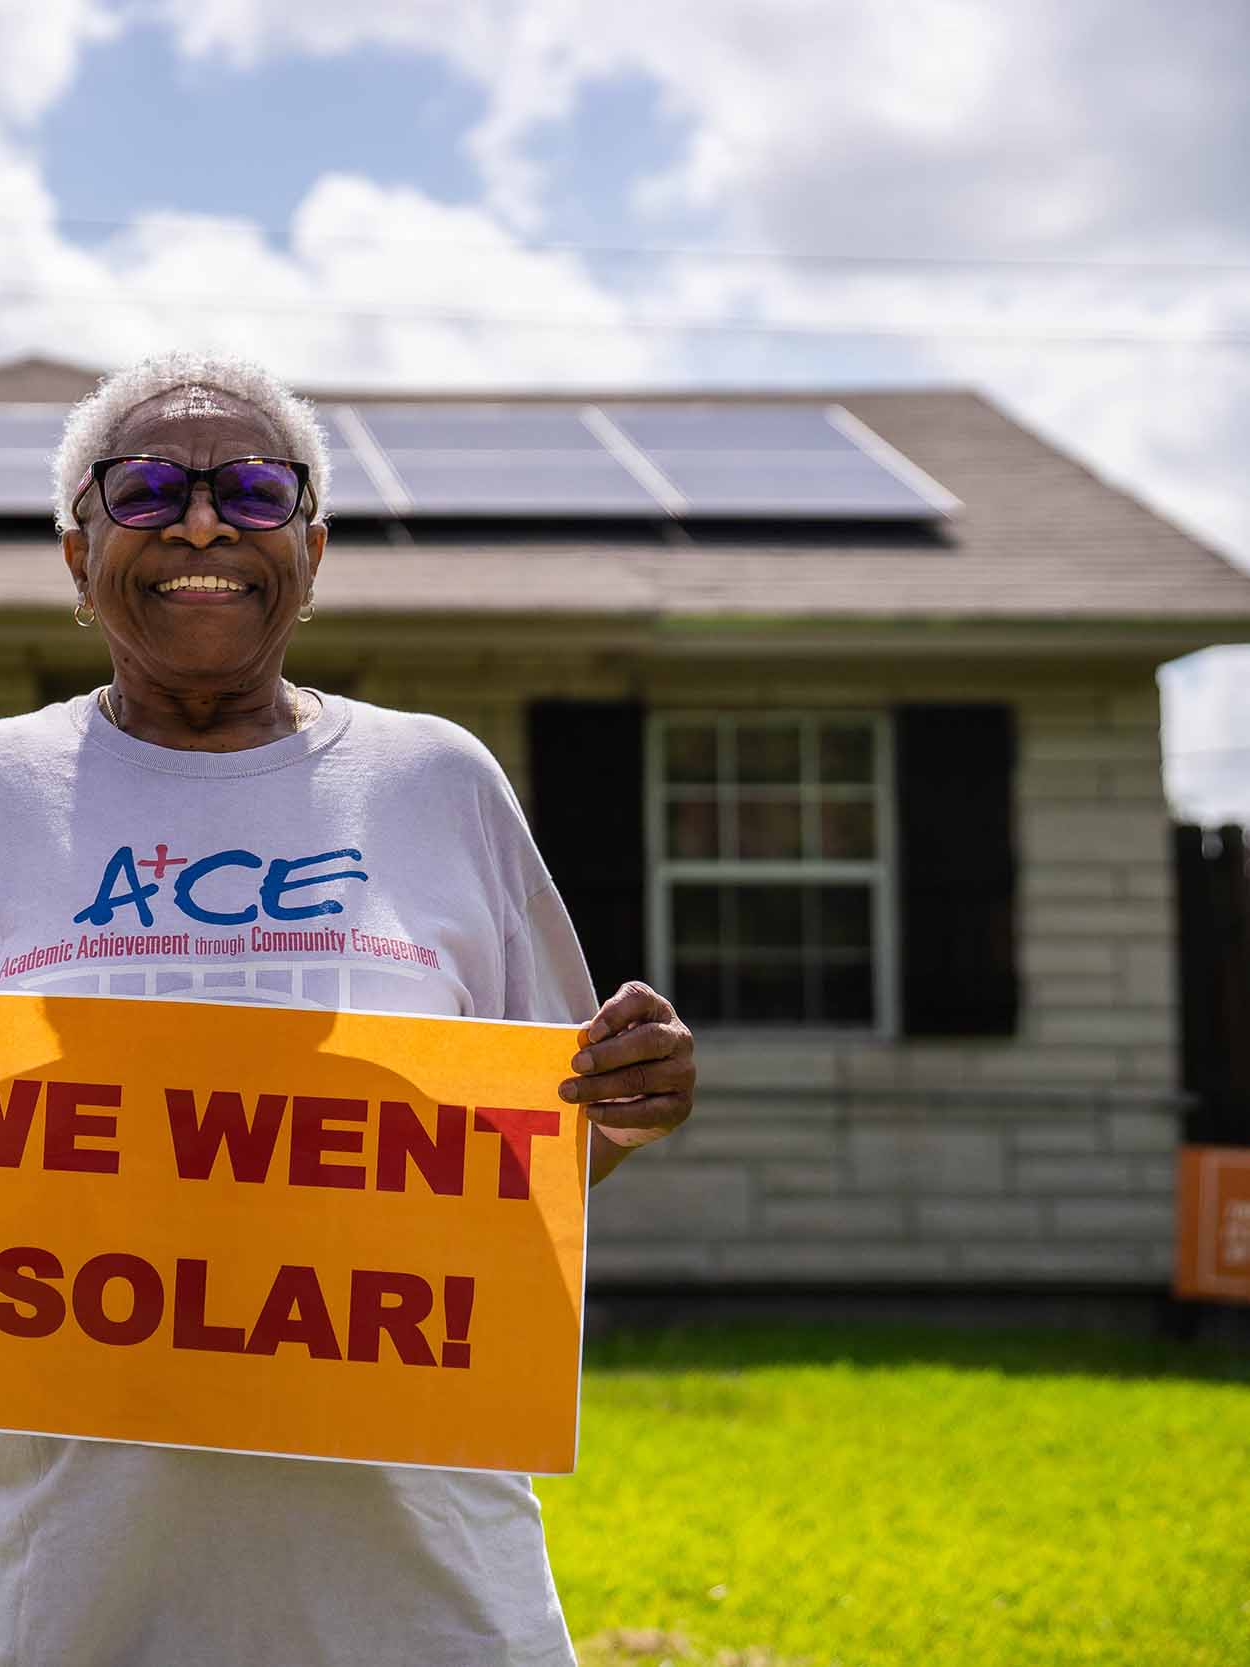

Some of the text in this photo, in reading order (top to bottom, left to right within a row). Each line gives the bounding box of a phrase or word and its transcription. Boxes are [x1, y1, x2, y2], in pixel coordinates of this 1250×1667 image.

[77, 931, 191, 960] Achievement
[195, 933, 246, 956] through
[251, 926, 347, 954] Community
[350, 928, 442, 970] Engagement
[165, 1088, 561, 1200] WENT
